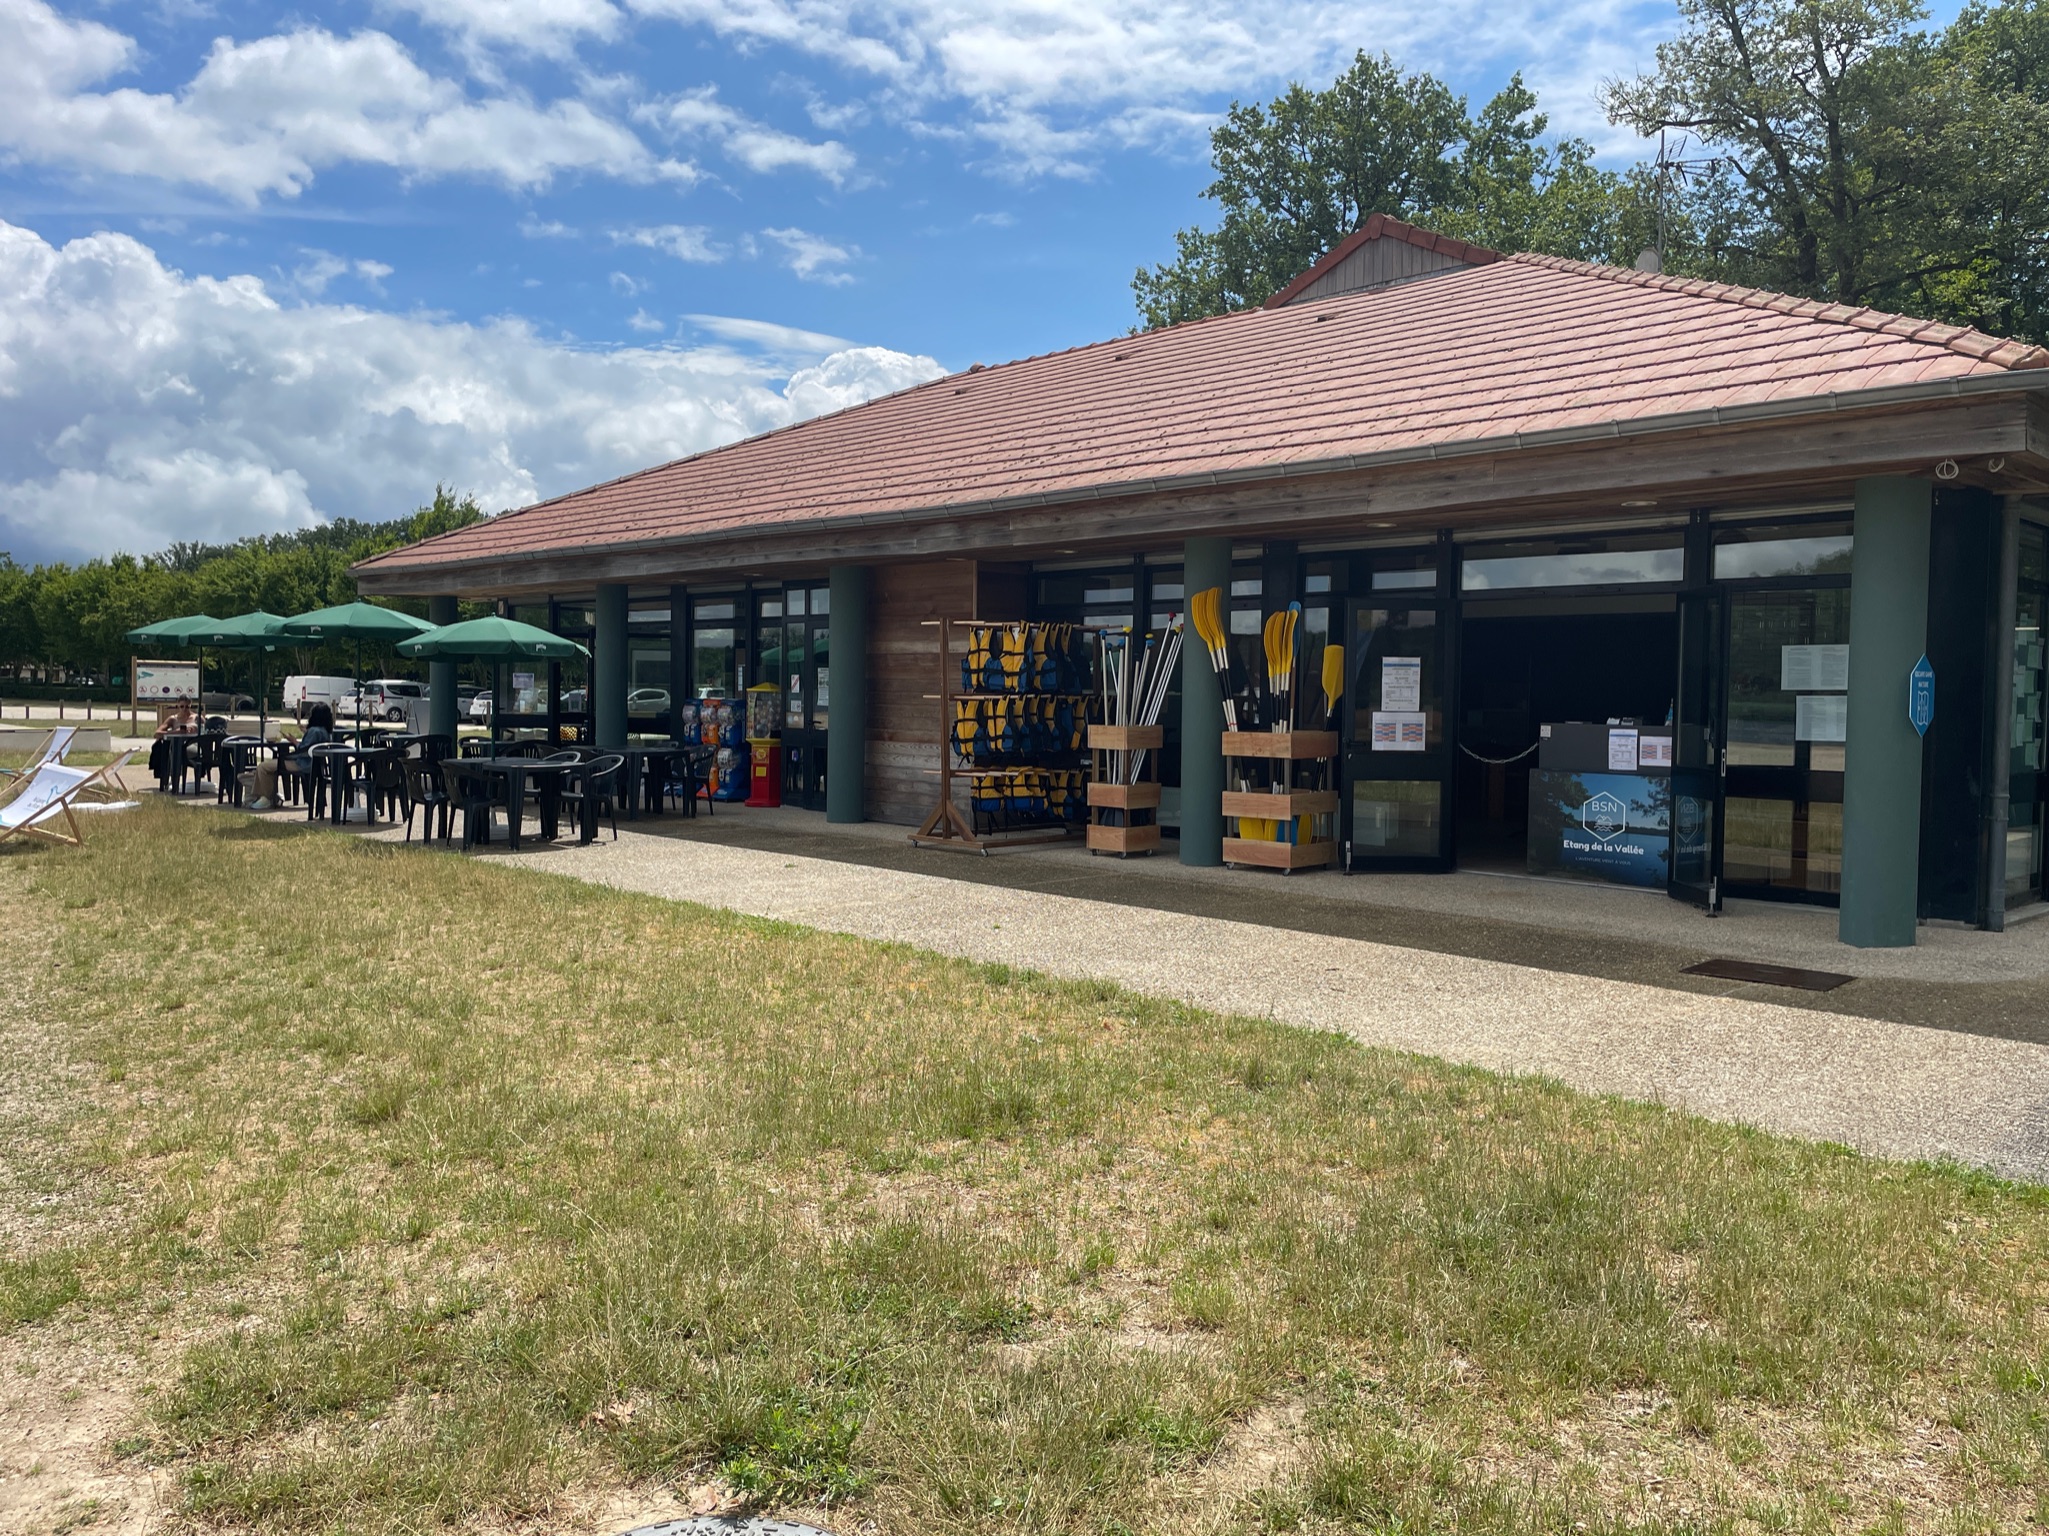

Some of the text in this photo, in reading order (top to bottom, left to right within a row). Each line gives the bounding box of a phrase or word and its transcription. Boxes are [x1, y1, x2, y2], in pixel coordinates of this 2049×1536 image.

[1591, 800, 1617, 813] BSN
[1563, 839, 1644, 855] Etang de la Vallée
